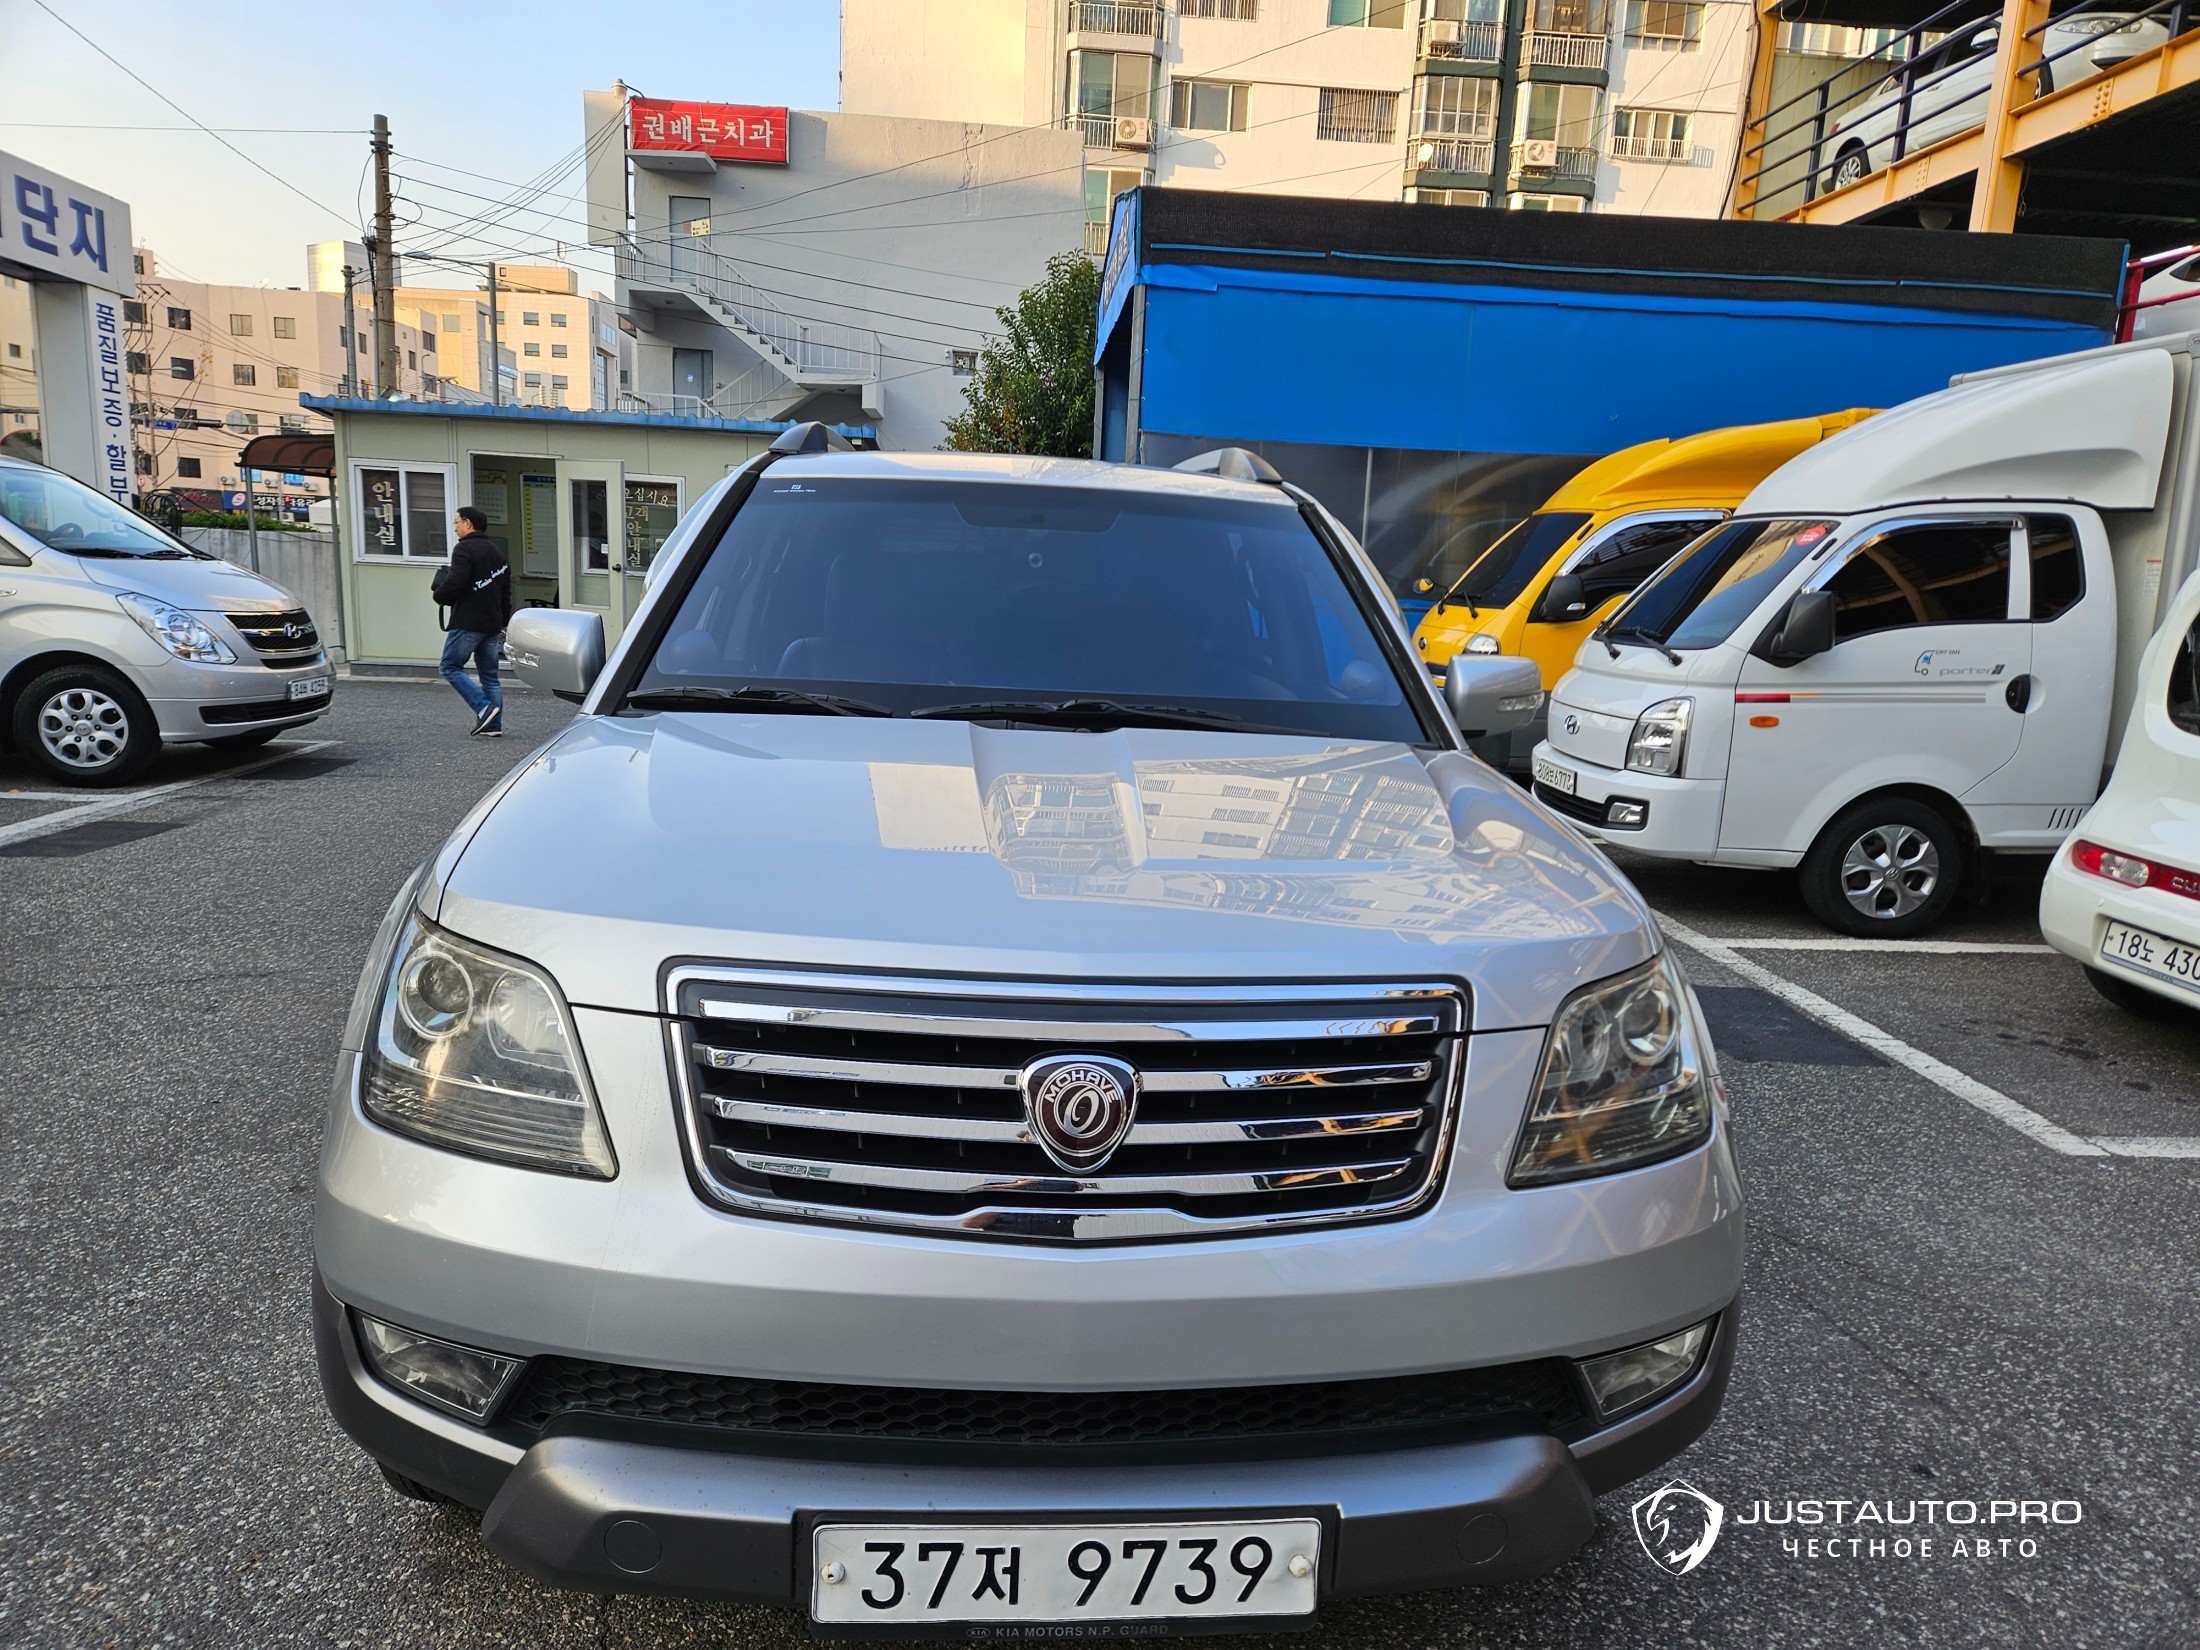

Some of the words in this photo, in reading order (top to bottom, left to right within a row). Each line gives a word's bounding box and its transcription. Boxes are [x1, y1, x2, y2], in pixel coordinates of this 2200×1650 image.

[642, 112, 774, 148] 권배근치과
[0, 173, 108, 273] 단지
[372, 481, 397, 545] 안내실
[626, 520, 642, 568] 안내실
[2118, 929, 2154, 963] 18노
[1044, 1069, 1119, 1104] MOHAVE
[860, 1541, 1021, 1610] 37저
[1066, 1536, 1274, 1607] 9739
[995, 1627, 1020, 1638] KIA
[1024, 1626, 1084, 1638] MOTORS
